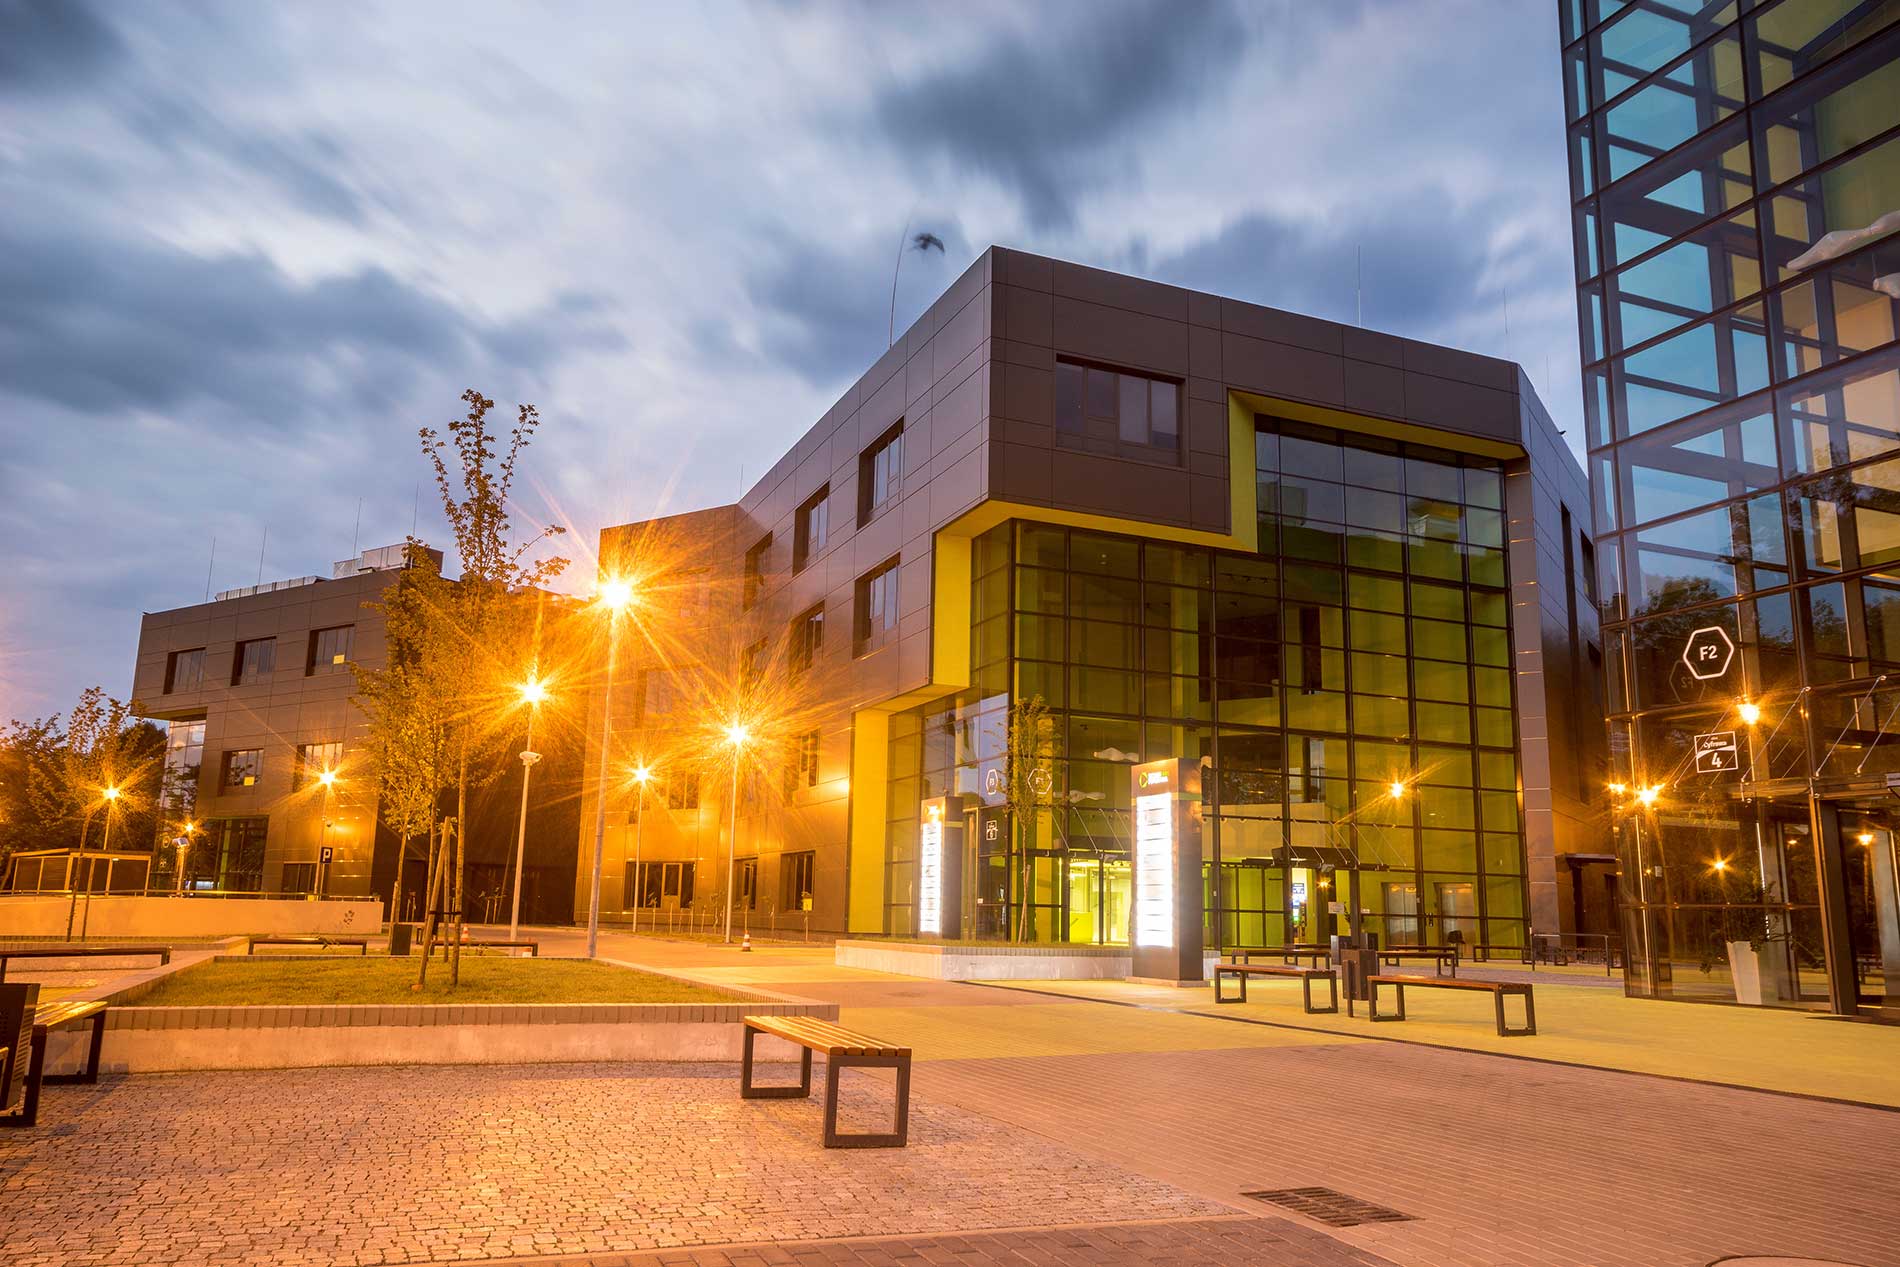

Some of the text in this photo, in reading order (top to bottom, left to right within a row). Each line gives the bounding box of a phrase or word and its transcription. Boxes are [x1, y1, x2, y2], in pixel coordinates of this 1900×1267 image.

[1699, 645, 1718, 661] F2
[1711, 752, 1722, 768] 4
[322, 848, 331, 862] P
